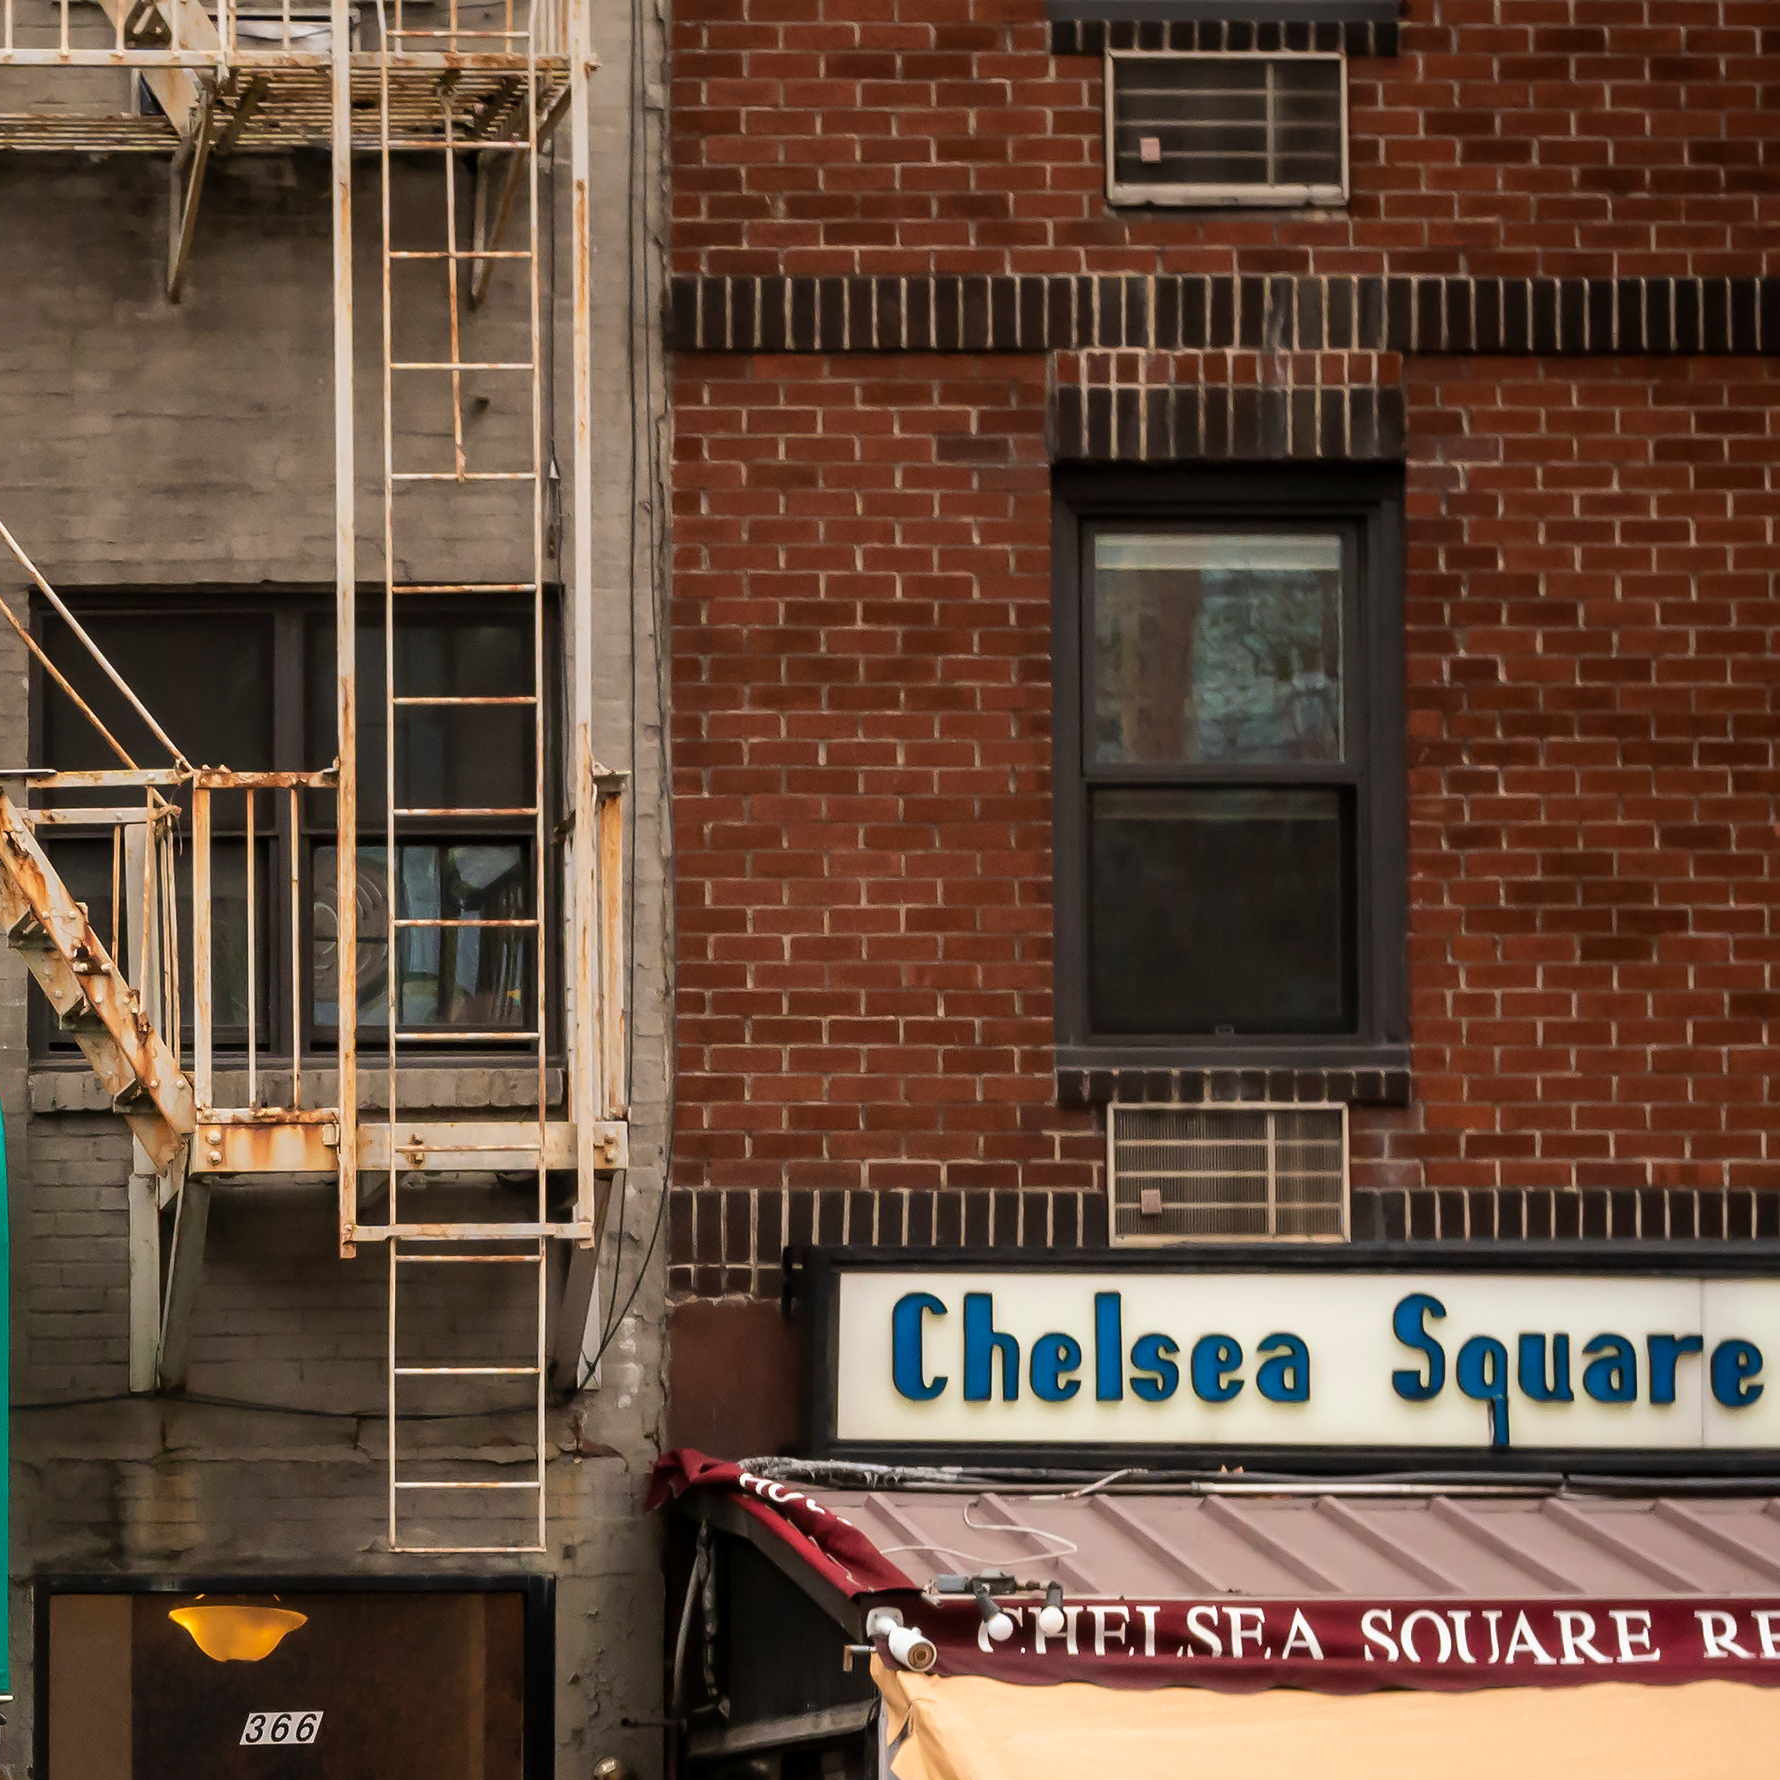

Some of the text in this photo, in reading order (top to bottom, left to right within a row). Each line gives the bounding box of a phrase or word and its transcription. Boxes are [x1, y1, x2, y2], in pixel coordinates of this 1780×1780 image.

[892, 1290, 1765, 1448] Chelsea Square
[245, 1713, 317, 1743] 366
